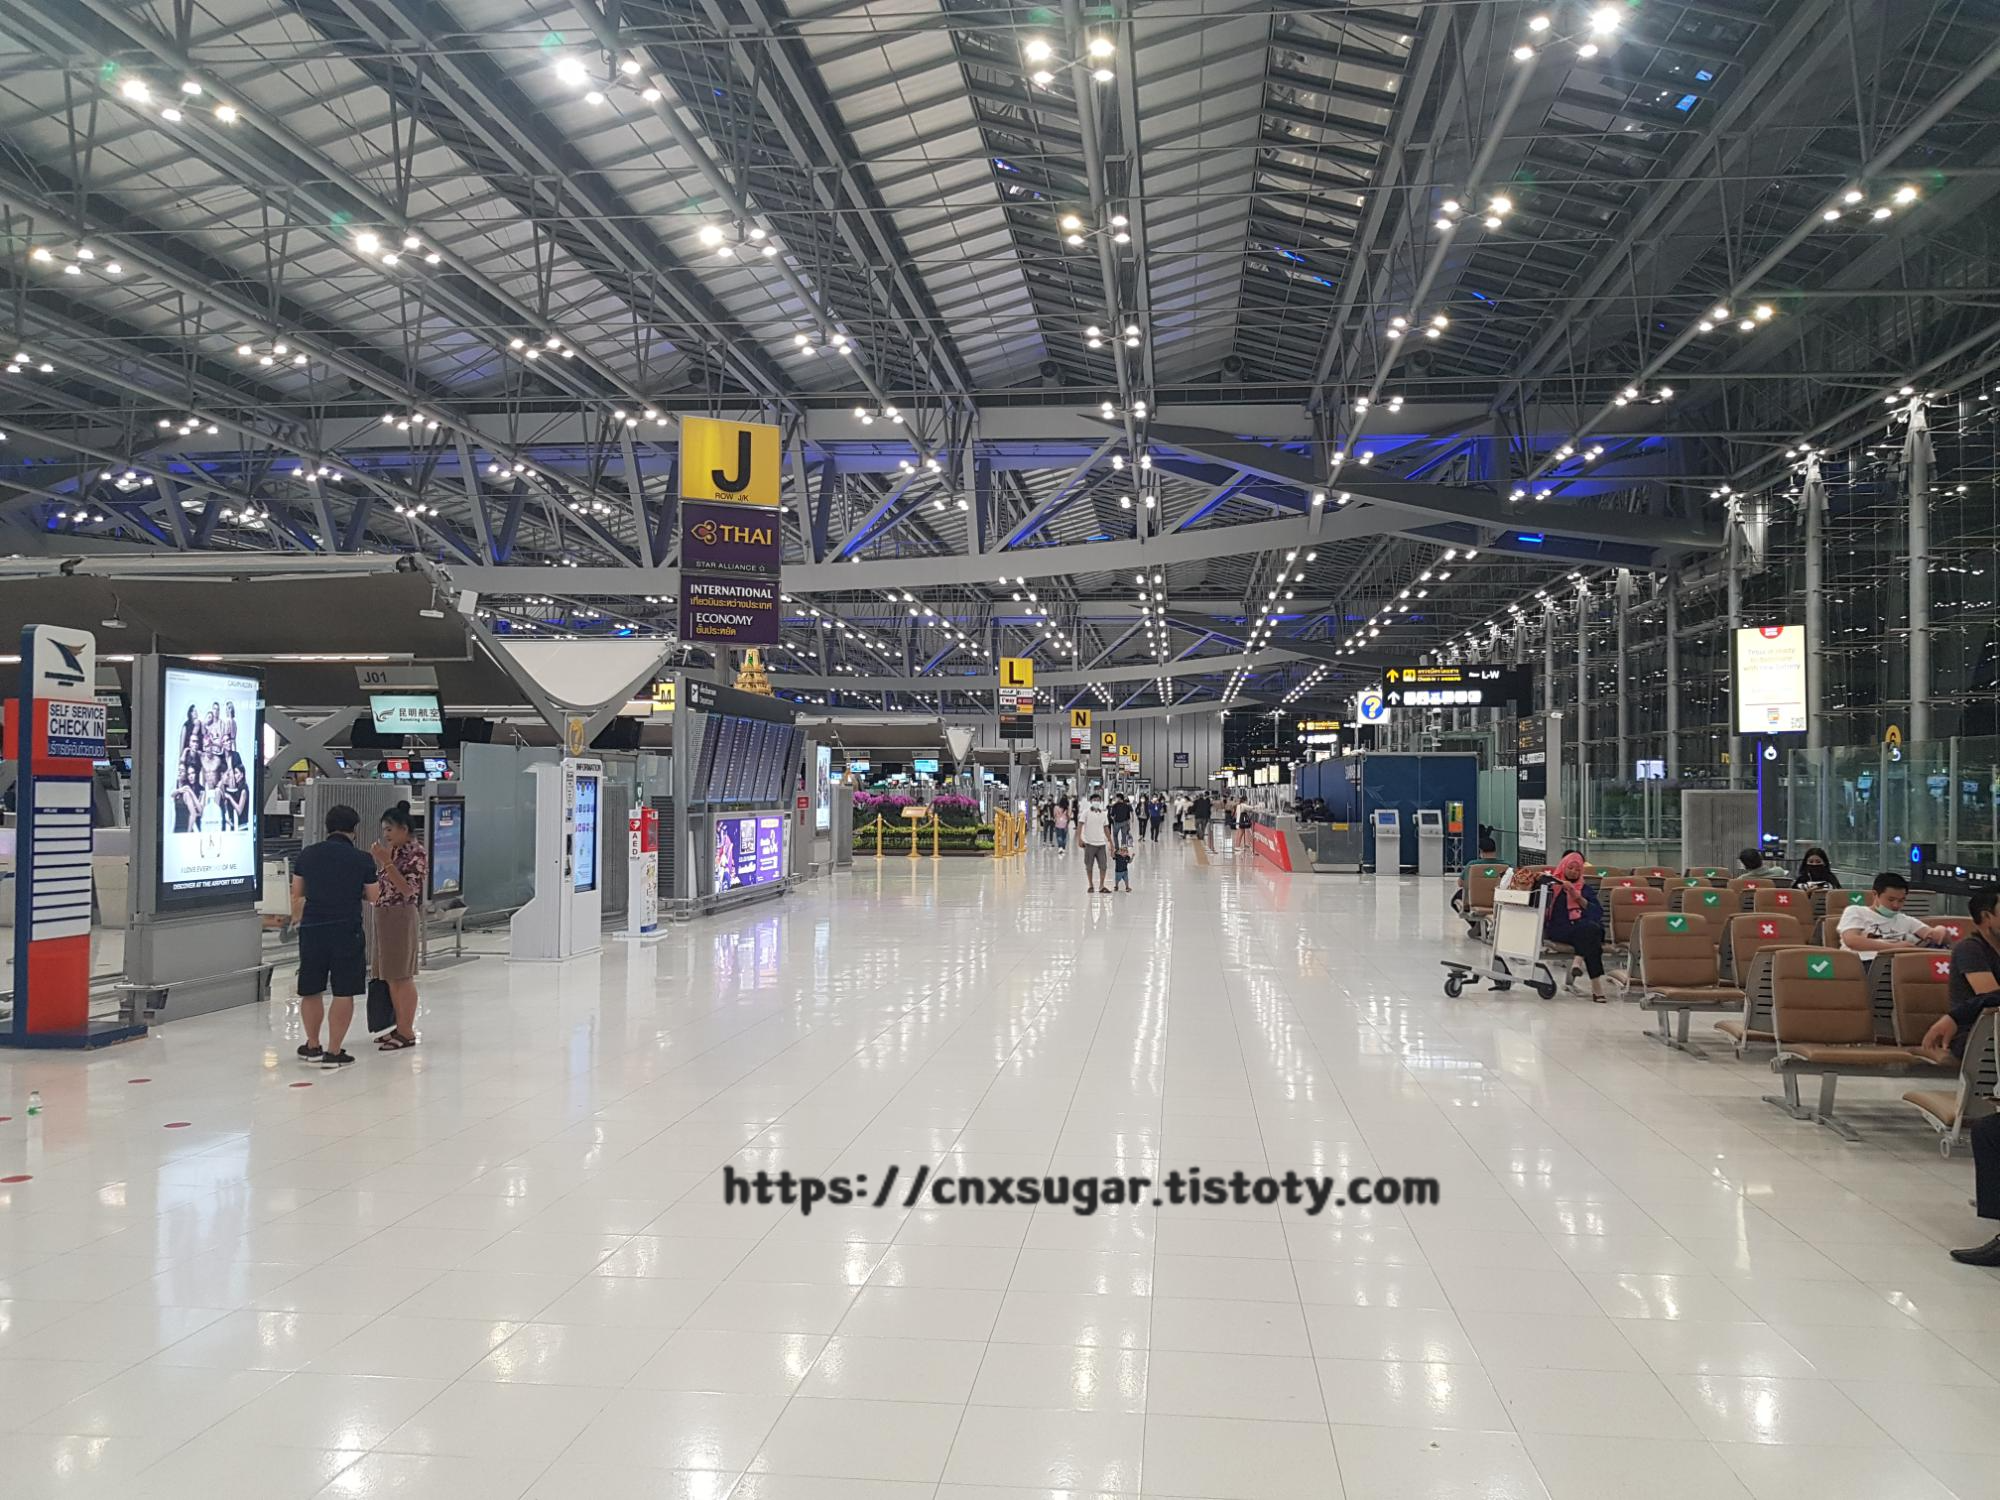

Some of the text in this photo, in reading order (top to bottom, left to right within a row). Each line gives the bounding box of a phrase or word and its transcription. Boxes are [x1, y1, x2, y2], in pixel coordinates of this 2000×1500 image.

[711, 430, 751, 493] J
[715, 492, 733, 500] ROW
[720, 525, 772, 545] THAI
[719, 562, 756, 571] ALLIANCE
[690, 584, 773, 599] INTERNATIONAL
[696, 612, 753, 626] ECONOMY
[364, 671, 387, 683] J01
[1009, 661, 1024, 684] L
[1481, 670, 1499, 679] L-W
[50, 704, 104, 720] SELF SERVICE
[1076, 712, 1086, 726] N
[50, 718, 104, 736] CHECK IN
[1104, 734, 1113, 744] Q
[1122, 747, 1128, 755] S
